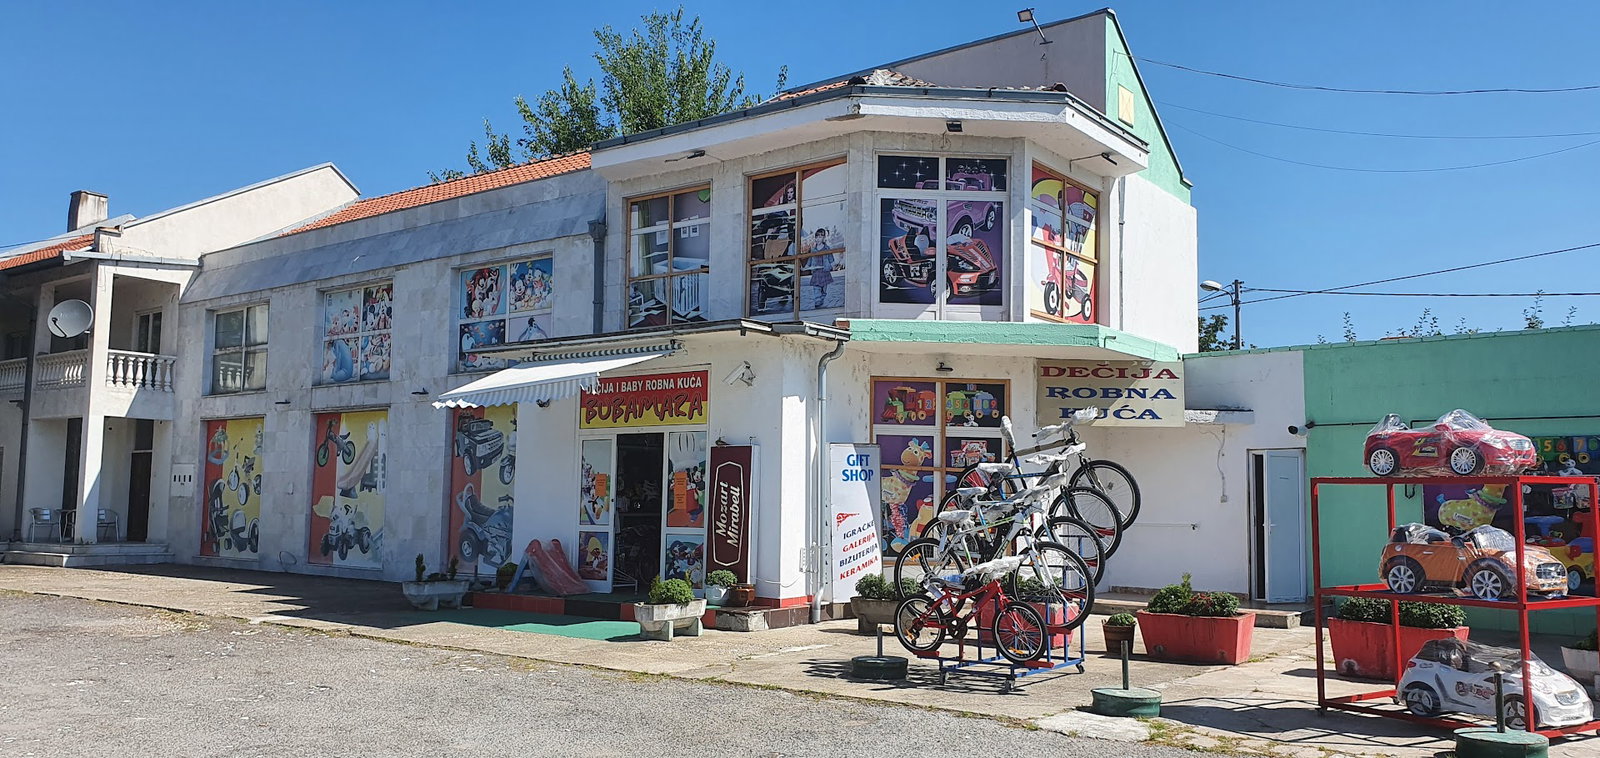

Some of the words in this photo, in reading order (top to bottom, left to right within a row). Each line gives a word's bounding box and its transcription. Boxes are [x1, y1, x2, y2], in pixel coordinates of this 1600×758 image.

[1041, 363, 1180, 380] DEČIJA
[616, 381, 620, 393] I
[621, 380, 643, 393] BABY
[645, 377, 675, 391] ROBNA
[677, 374, 702, 389] KUĆA
[1045, 386, 1177, 400] ROBNA
[585, 391, 704, 425] BUBAMARA
[847, 454, 870, 467] GIFT
[842, 469, 874, 482] SHOP
[716, 481, 729, 537] Mozart
[727, 486, 740, 548] Mirabell
[842, 532, 876, 553] GALERIJA
[840, 555, 879, 580] KERAMIKA
